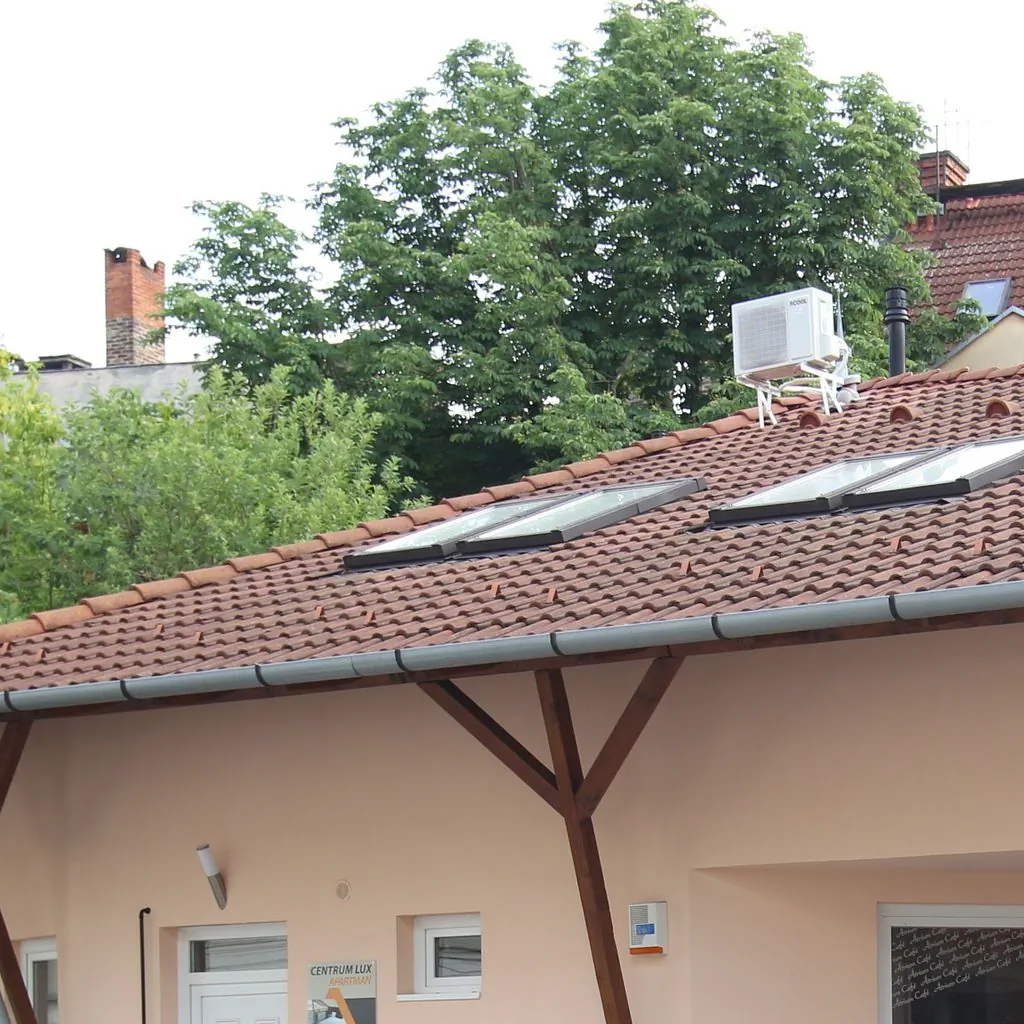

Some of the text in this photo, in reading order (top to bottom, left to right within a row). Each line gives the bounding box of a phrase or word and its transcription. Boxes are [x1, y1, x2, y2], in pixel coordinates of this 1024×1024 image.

[310, 964, 372, 976] CENTRUM LUX
[330, 976, 371, 985] APARTMAN
